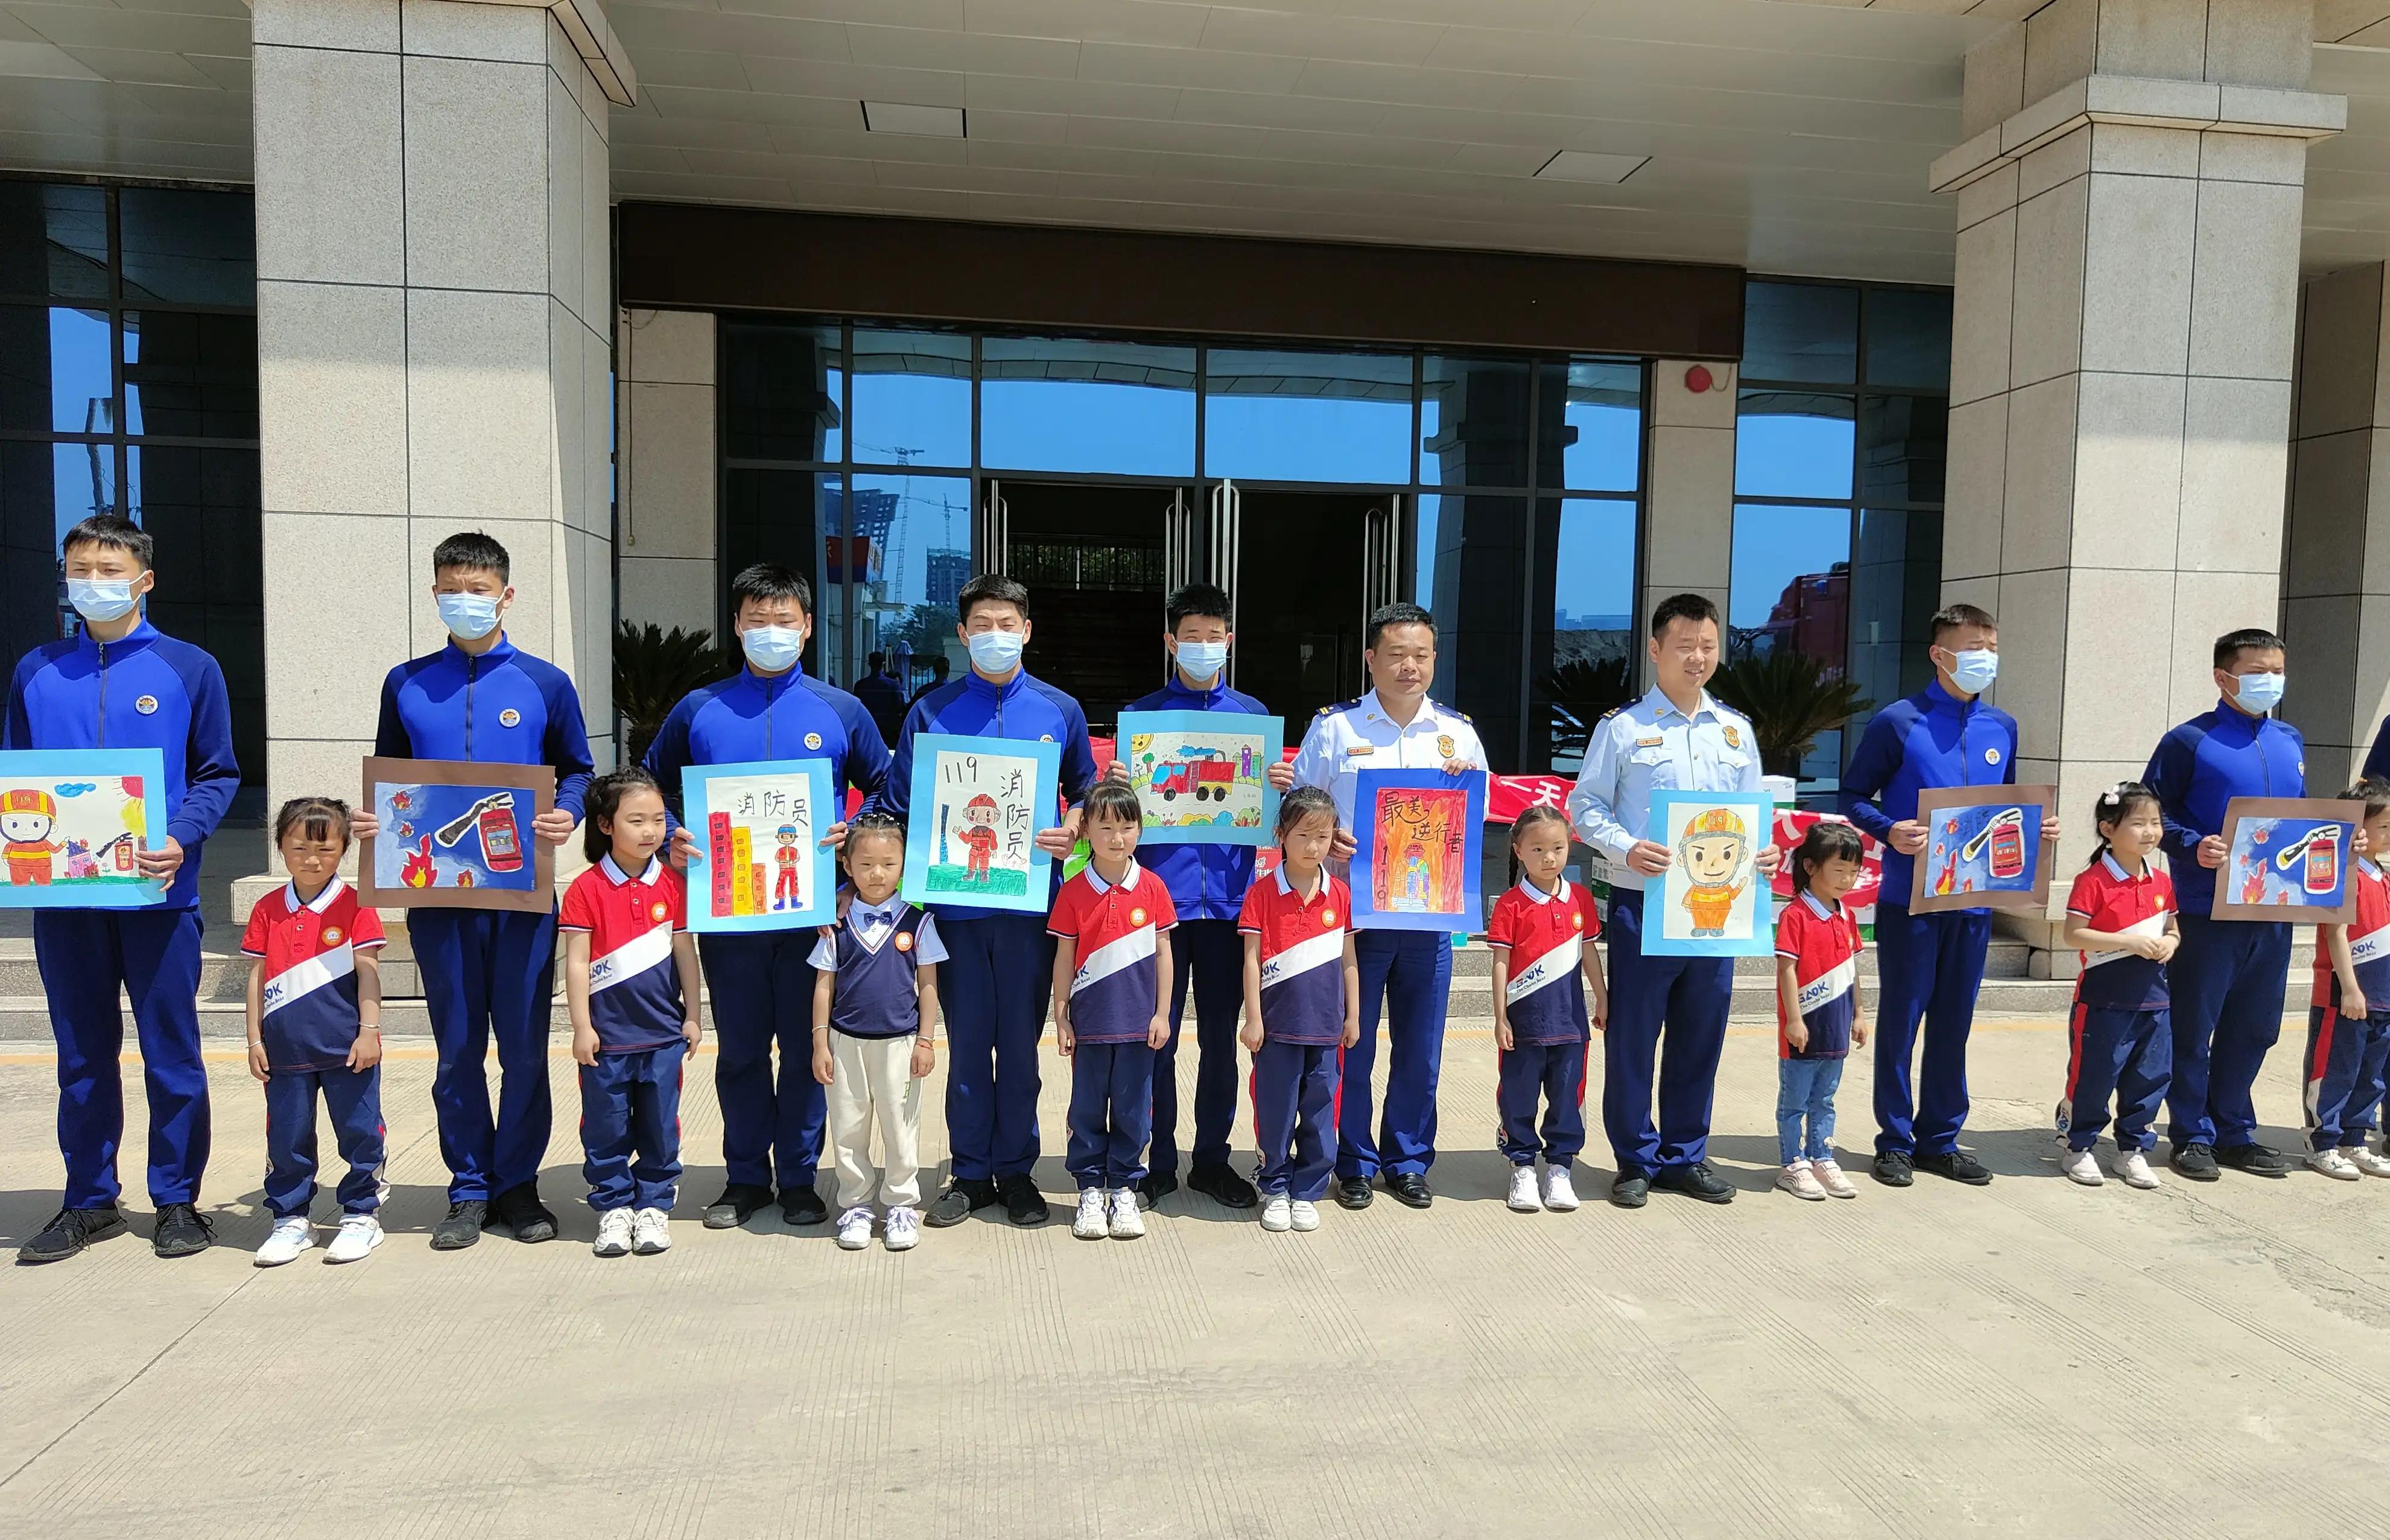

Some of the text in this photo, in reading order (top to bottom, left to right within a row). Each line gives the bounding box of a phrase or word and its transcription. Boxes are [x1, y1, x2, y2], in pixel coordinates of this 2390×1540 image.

[945, 756, 977, 783] 119
[738, 789, 808, 827] 消防员
[1381, 791, 1430, 827] 最美
[1500, 780, 1571, 811] 一天
[1000, 768, 1030, 860] 消防员
[1412, 821, 1463, 854] 逆行者
